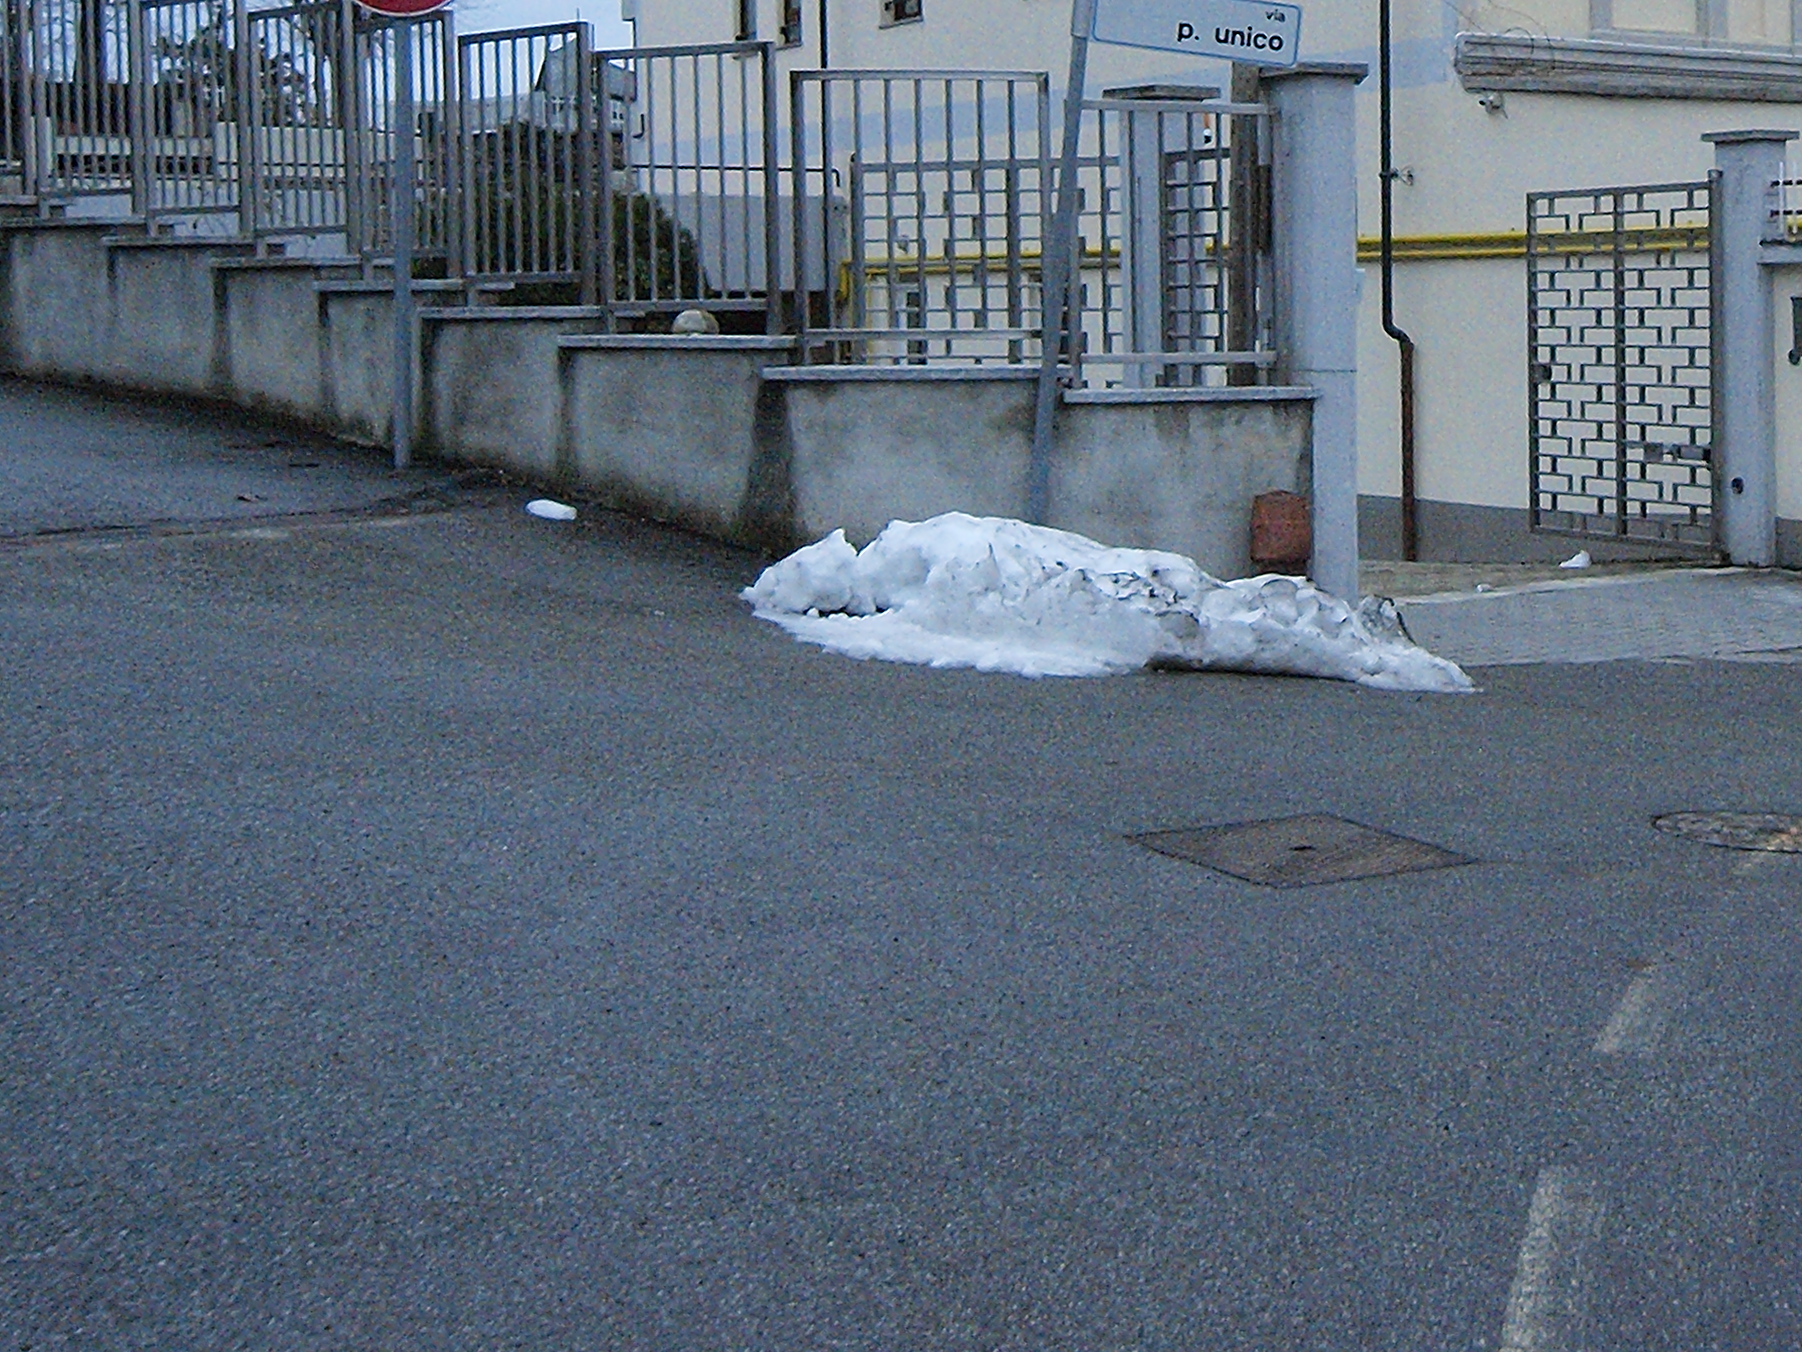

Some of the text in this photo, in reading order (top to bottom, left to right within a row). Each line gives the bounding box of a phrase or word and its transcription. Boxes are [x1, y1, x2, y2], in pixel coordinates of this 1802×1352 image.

[1266, 9, 1286, 22] via
[1177, 22, 1284, 51] p. unico
